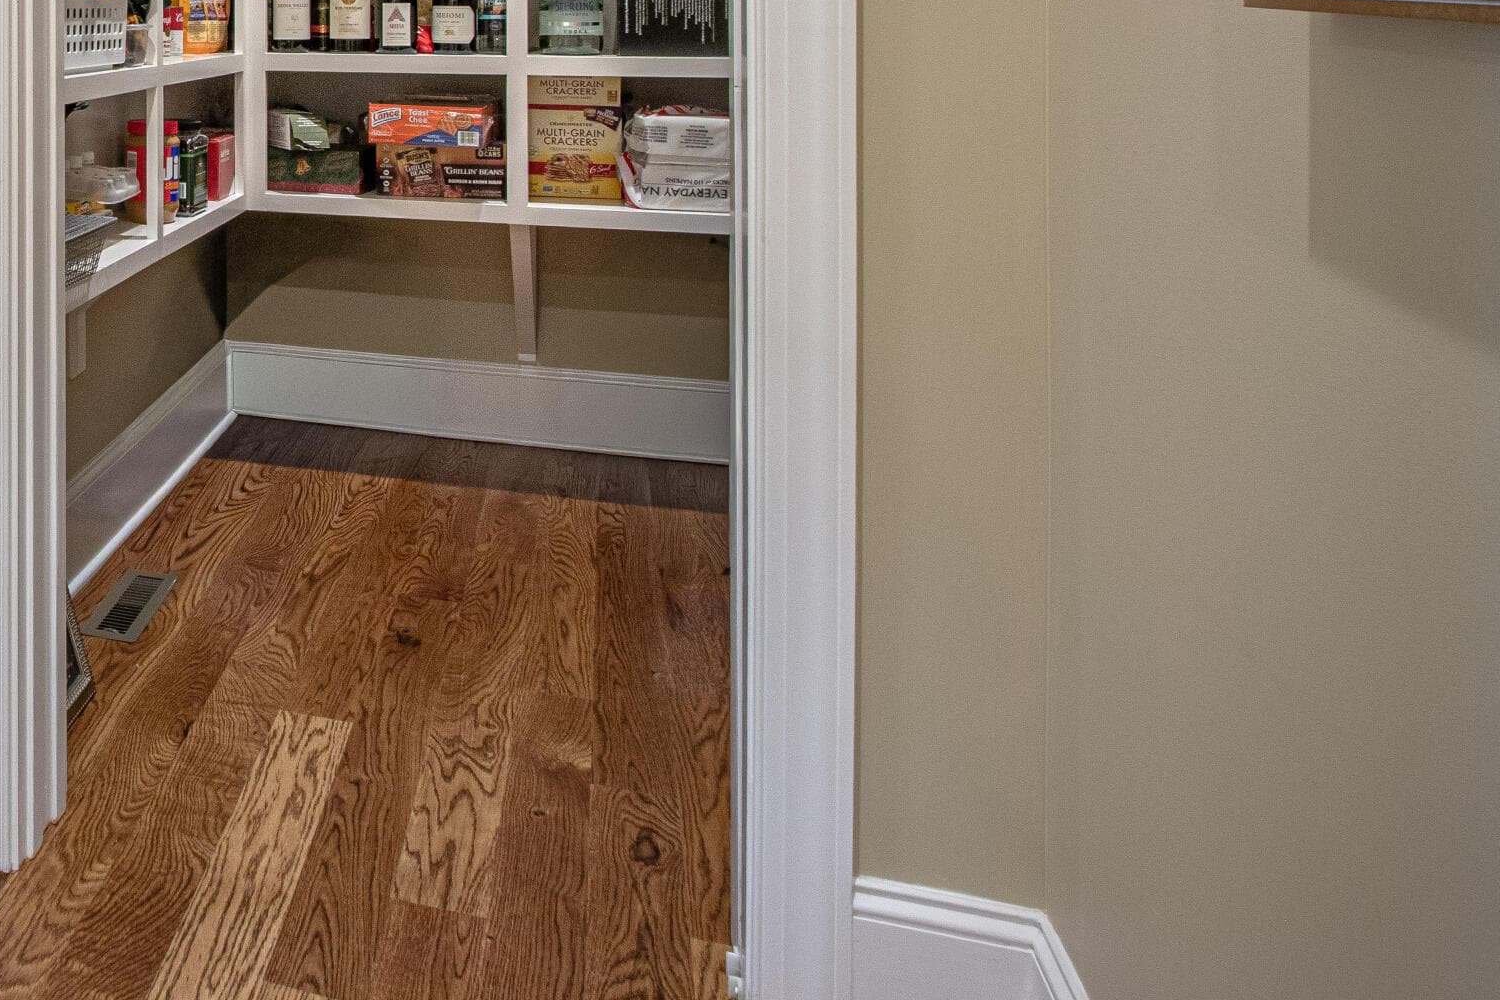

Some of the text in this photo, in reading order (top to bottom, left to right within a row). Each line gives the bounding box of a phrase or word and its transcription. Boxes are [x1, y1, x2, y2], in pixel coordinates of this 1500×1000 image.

[539, 79, 605, 89] MULTI-GRAIN
[545, 86, 597, 97] CRACKERS
[373, 110, 399, 122] Lance
[408, 108, 429, 116] Toast
[408, 116, 428, 124] Chee
[536, 127, 605, 138] MULTI-GRAIN
[543, 136, 598, 147] CRACKERS
[478, 166, 505, 176] BEANS
[663, 187, 728, 199] EVERYDAY
